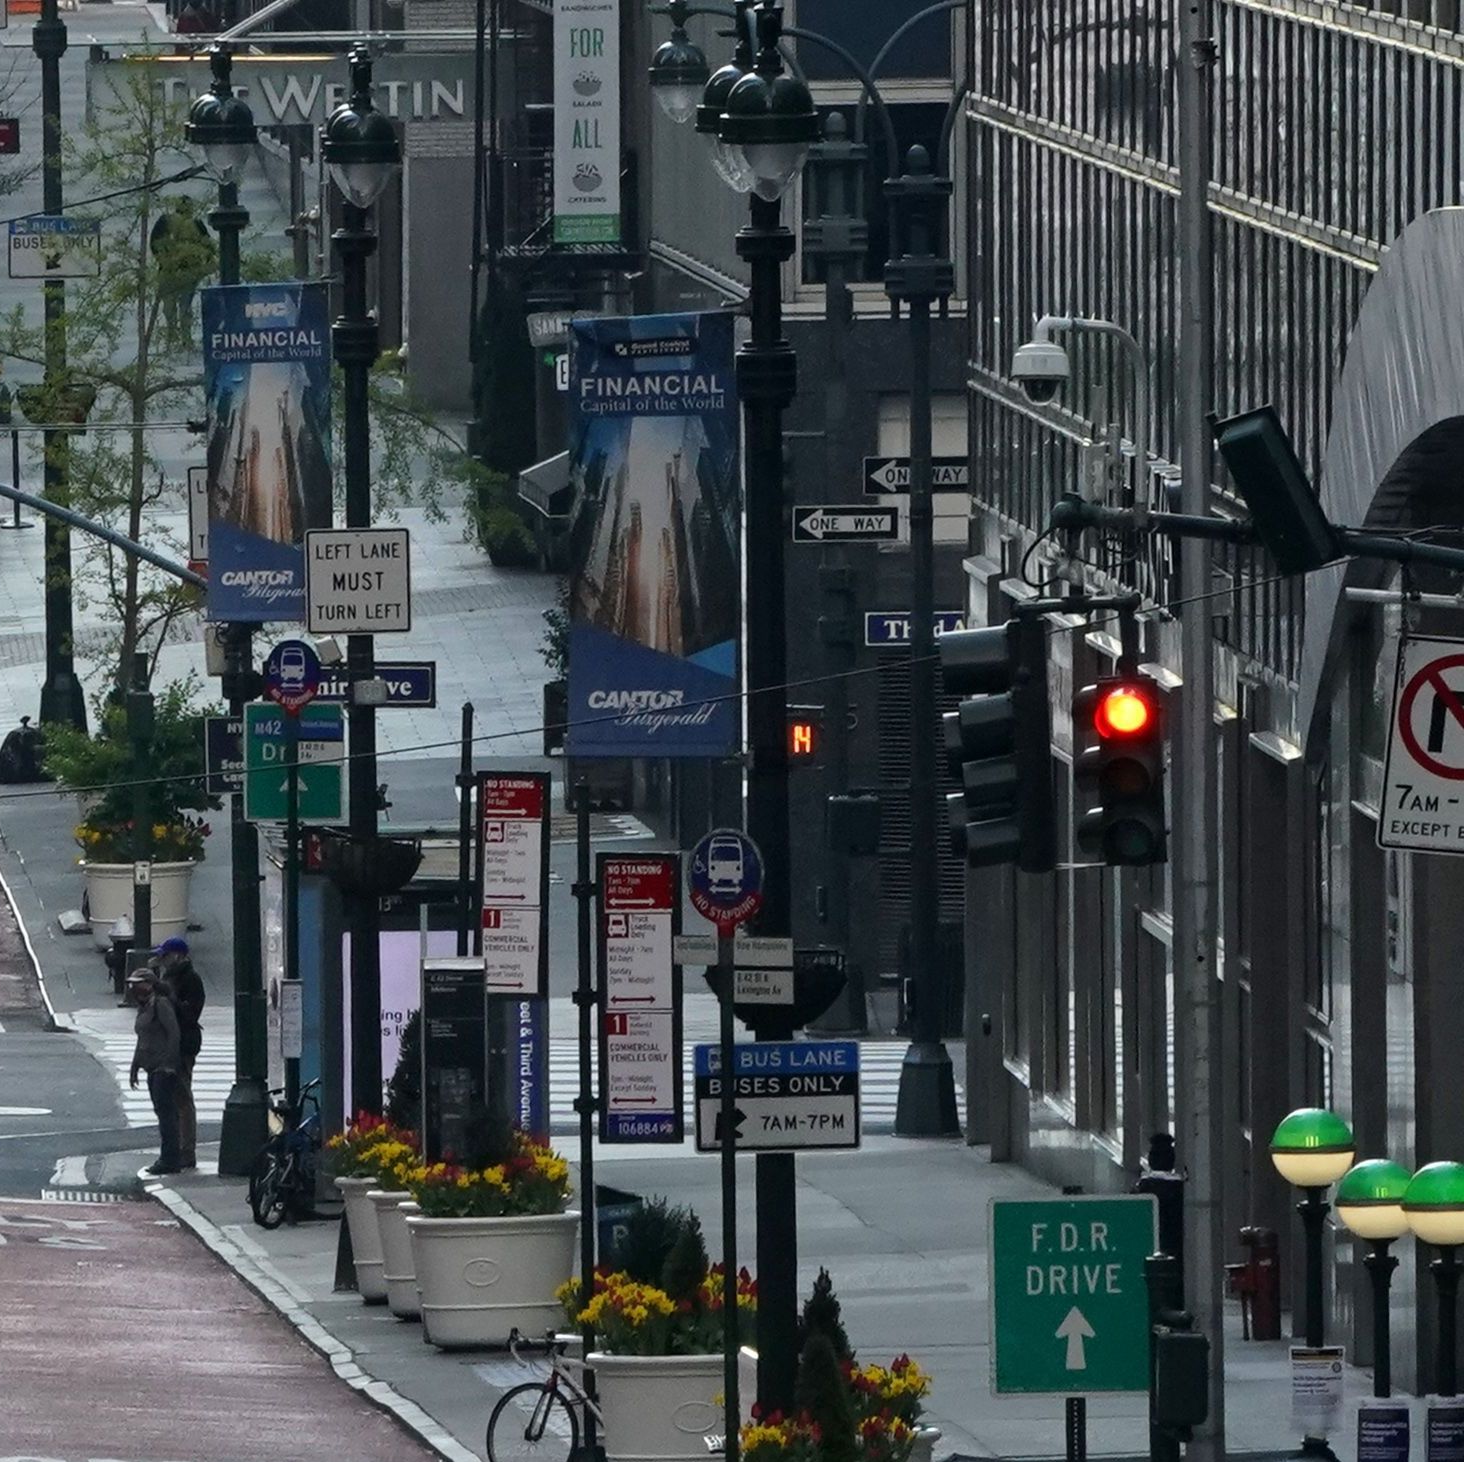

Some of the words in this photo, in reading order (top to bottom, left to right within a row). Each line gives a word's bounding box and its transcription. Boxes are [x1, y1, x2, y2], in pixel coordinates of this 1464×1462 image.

[570, 28, 604, 58] FOR
[156, 77, 249, 100] TE
[258, 74, 464, 120] WETIN
[572, 118, 602, 149] ALL
[211, 330, 322, 348] FINANCIAL
[211, 350, 252, 362] Capital
[254, 350, 264, 359] of
[267, 348, 285, 359] the
[289, 345, 322, 358] World
[580, 375, 725, 396] FINANCIAL
[580, 400, 631, 415] Capital
[636, 399, 650, 412] of
[655, 398, 678, 411] the
[681, 396, 724, 409] World
[885, 468, 907, 484] ON
[810, 518, 839, 531] ONE
[854, 518, 885, 531] WAY
[315, 543, 352, 560] LEFT
[360, 542, 401, 559] LANE
[221, 570, 295, 587] CANTOR
[333, 571, 385, 592] MUST
[316, 604, 357, 620] TURN
[365, 603, 402, 620] LEFT
[588, 690, 684, 709] CANTOR
[255, 720, 282, 735] M42
[614, 702, 719, 735] Fitzgerald
[226, 723, 243, 734] NY
[486, 780, 498, 788] NO
[499, 780, 535, 789] STANDING
[1396, 785, 1439, 812] 7AM
[1391, 820, 1451, 838] EXCEPT
[608, 865, 620, 874] NO
[621, 865, 663, 875] STANDING
[618, 887, 634, 895] Days
[695, 895, 709, 910] NO
[710, 895, 756, 920] STANDING
[489, 911, 495, 927] 1
[519, 1001, 532, 1023] eet
[519, 1027, 533, 1038] &
[613, 1015, 621, 1033] 1
[610, 1043, 660, 1052] COMMERCIAL
[520, 1041, 533, 1076] Third
[611, 1053, 647, 1062] VEHICLES
[648, 1053, 669, 1062] ONLY
[741, 1051, 782, 1068] BUS
[790, 1050, 847, 1067] LANE
[710, 1077, 781, 1095] BSES
[789, 1076, 845, 1093] ONLY
[520, 1079, 533, 1131] Avenue
[618, 1123, 658, 1135] 106884
[761, 1114, 845, 1131] 7AM-7PM
[1032, 1222, 1117, 1253] F.D.R.
[1026, 1264, 1122, 1296] DRIVE
